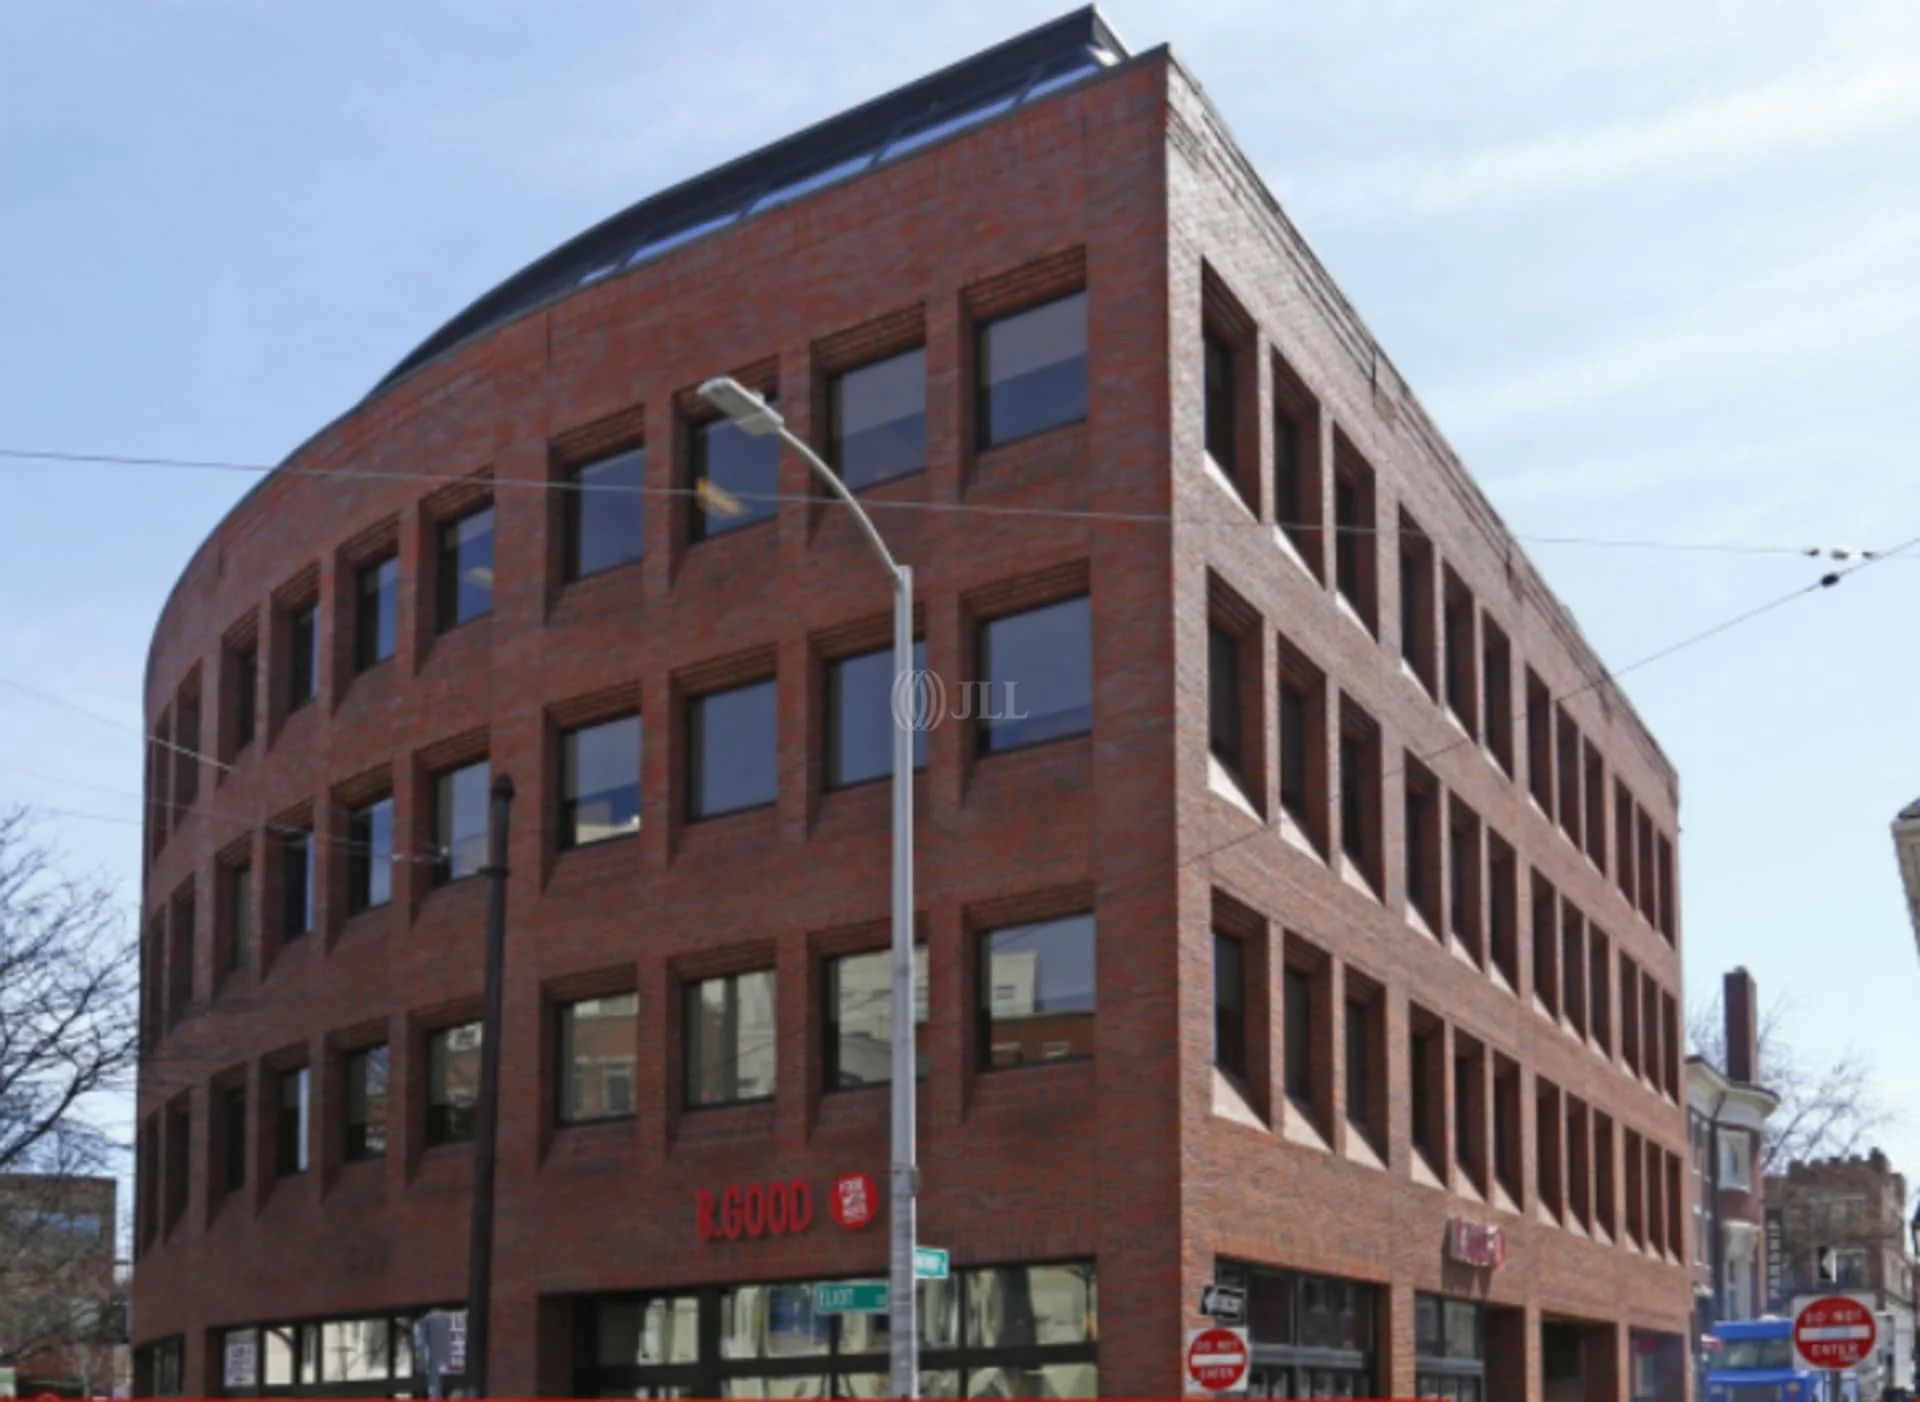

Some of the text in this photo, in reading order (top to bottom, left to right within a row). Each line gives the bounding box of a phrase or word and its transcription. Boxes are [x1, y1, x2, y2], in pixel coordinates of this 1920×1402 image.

[697, 1179, 812, 1240] B.GOOD
[1805, 1307, 1863, 1324] DO NOT
[1195, 1341, 1238, 1352] DO NOT
[1811, 1342, 1858, 1357] ENTER
